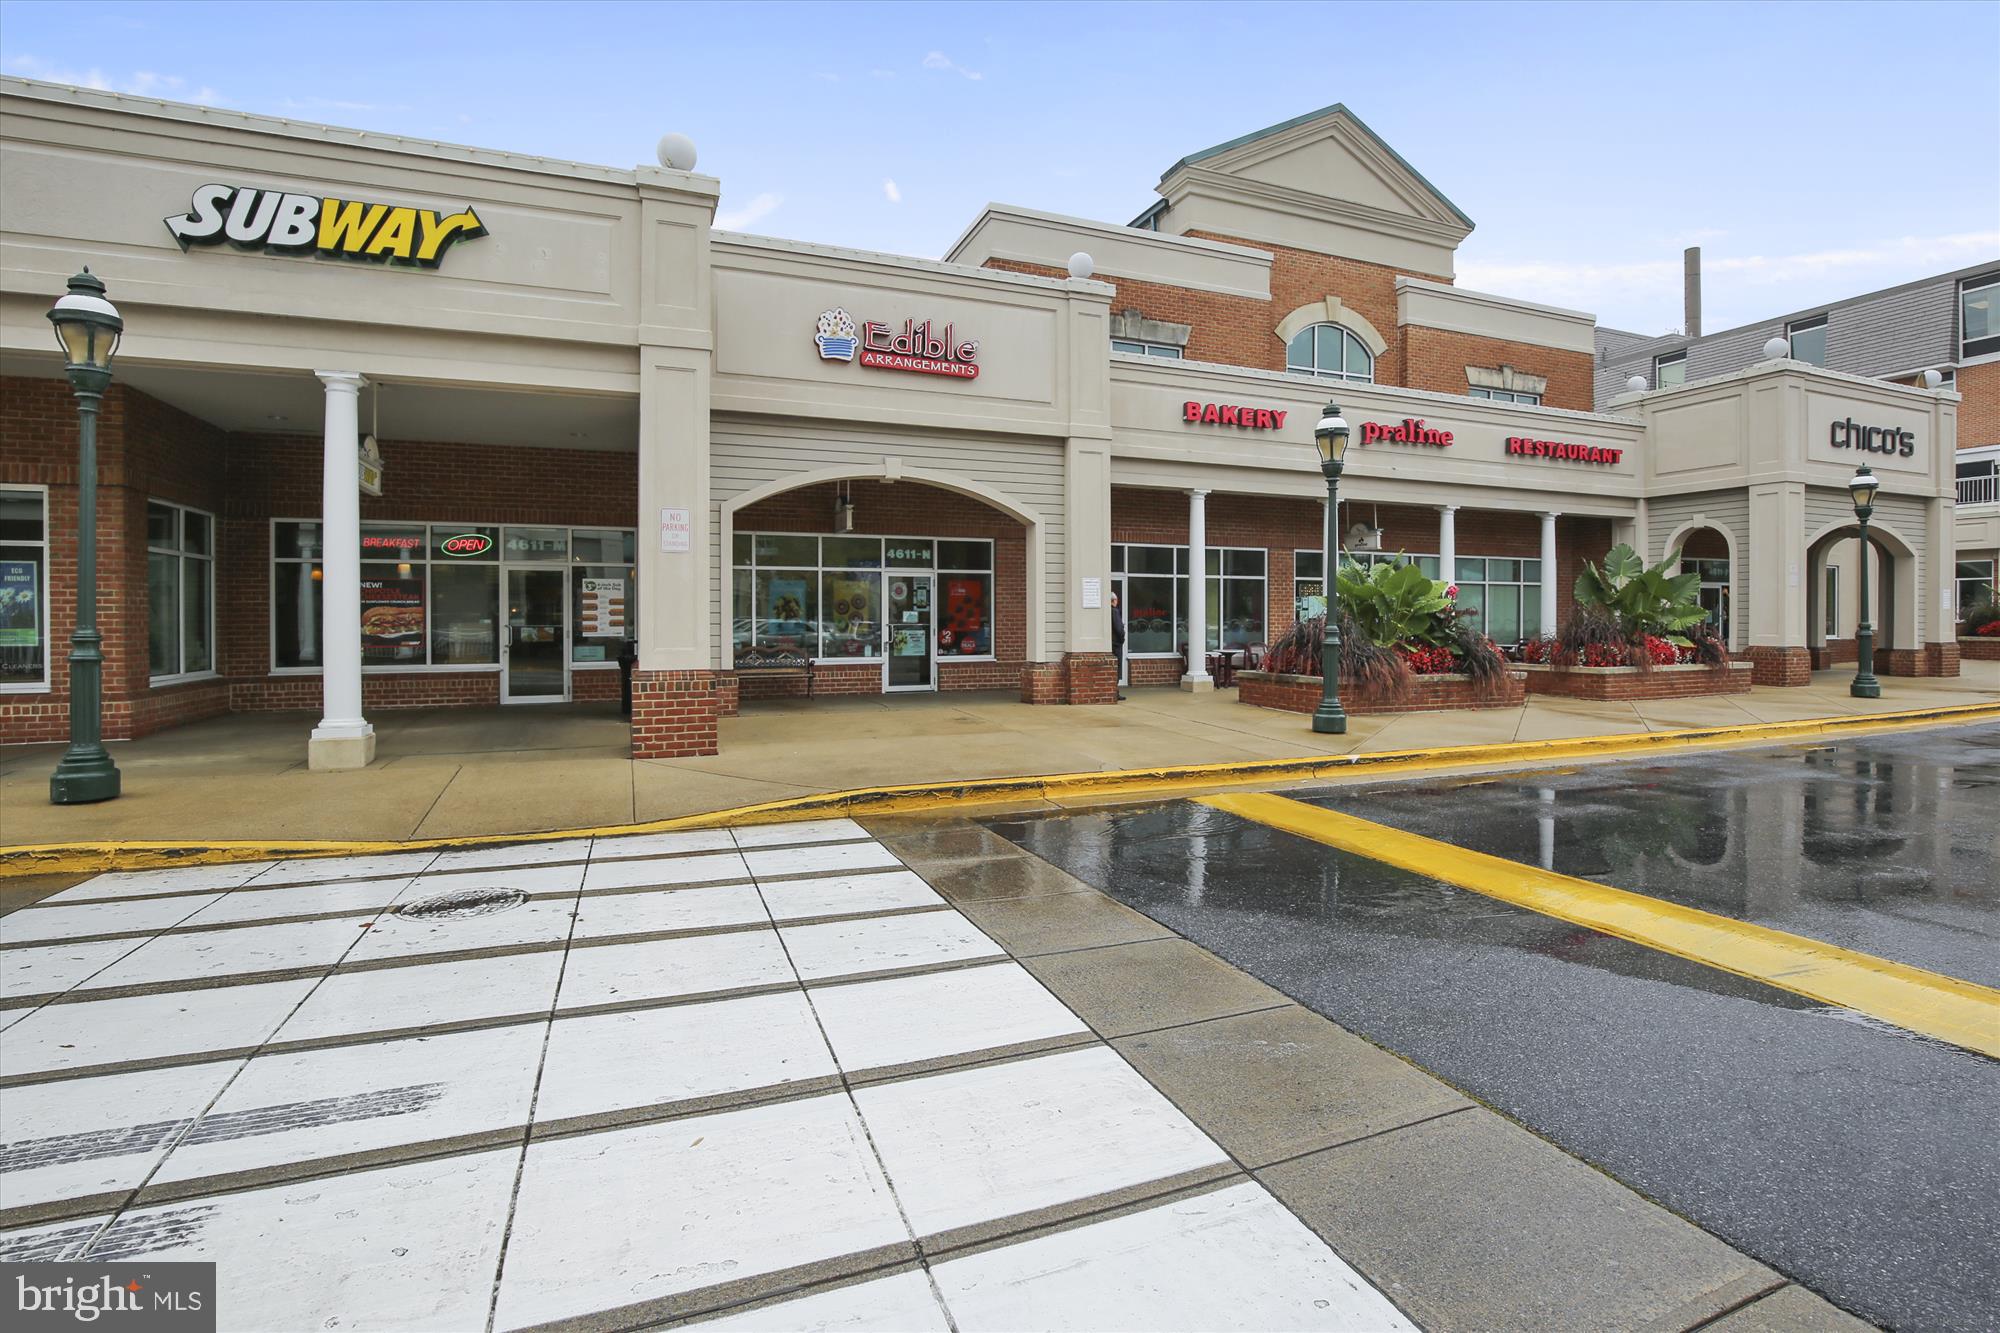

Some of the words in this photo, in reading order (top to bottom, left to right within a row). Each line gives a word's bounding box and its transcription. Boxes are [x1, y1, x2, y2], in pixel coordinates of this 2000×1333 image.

[163, 183, 488, 267] SUBWAY
[864, 318, 978, 362] Edible
[864, 354, 975, 375] ARRANGEMENTS
[1184, 401, 1287, 429] BAKERY
[1360, 418, 1454, 447] praline
[1506, 437, 1623, 464] RESTAURANT
[670, 512, 681, 521] NO
[662, 522, 689, 532] PARKING
[362, 537, 420, 550] BREAKFAST
[447, 539, 486, 551] OPEN
[506, 539, 567, 551] 4611-M
[887, 549, 931, 559] 4611-N
